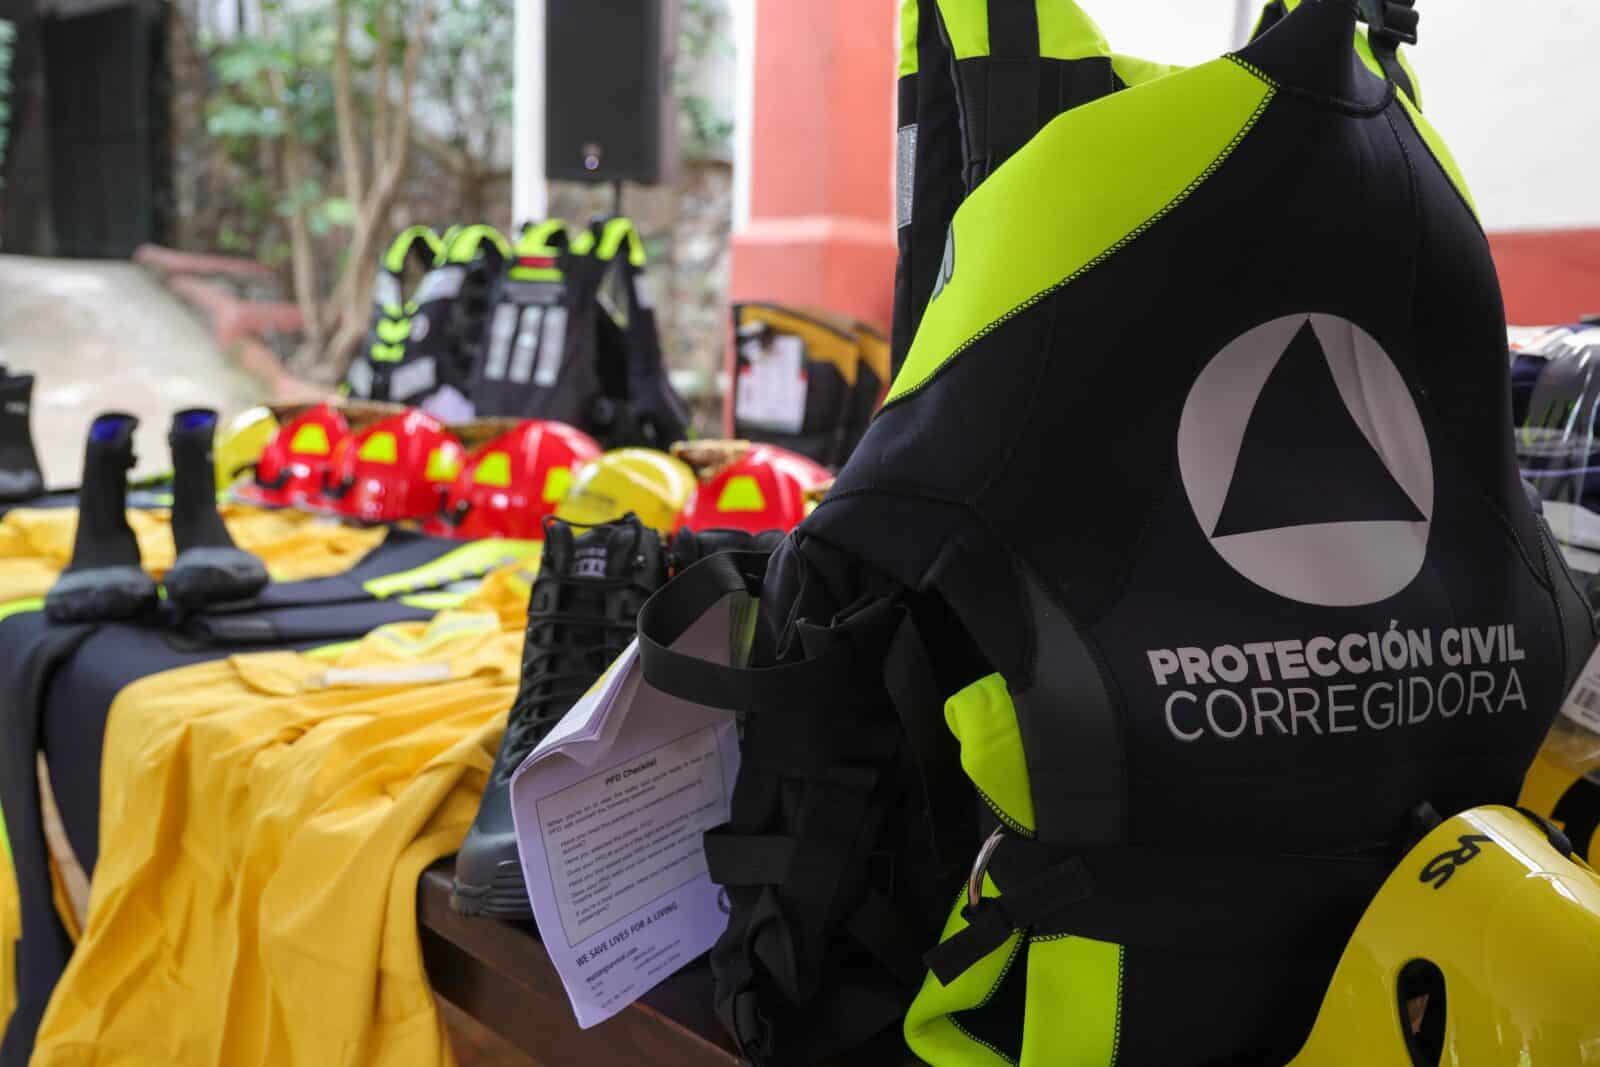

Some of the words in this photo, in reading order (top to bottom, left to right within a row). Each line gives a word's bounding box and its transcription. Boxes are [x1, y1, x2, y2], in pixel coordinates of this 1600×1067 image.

[1147, 619, 1433, 686] PROTECCIÓN
[1440, 624, 1525, 666] CIVIL
[1165, 667, 1527, 742] CORREGIDORA
[576, 953, 590, 968] WE
[590, 941, 609, 960] SAVE
[608, 928, 630, 947] LIVES
[630, 919, 646, 934] FOR
[653, 900, 678, 921] LIVING
